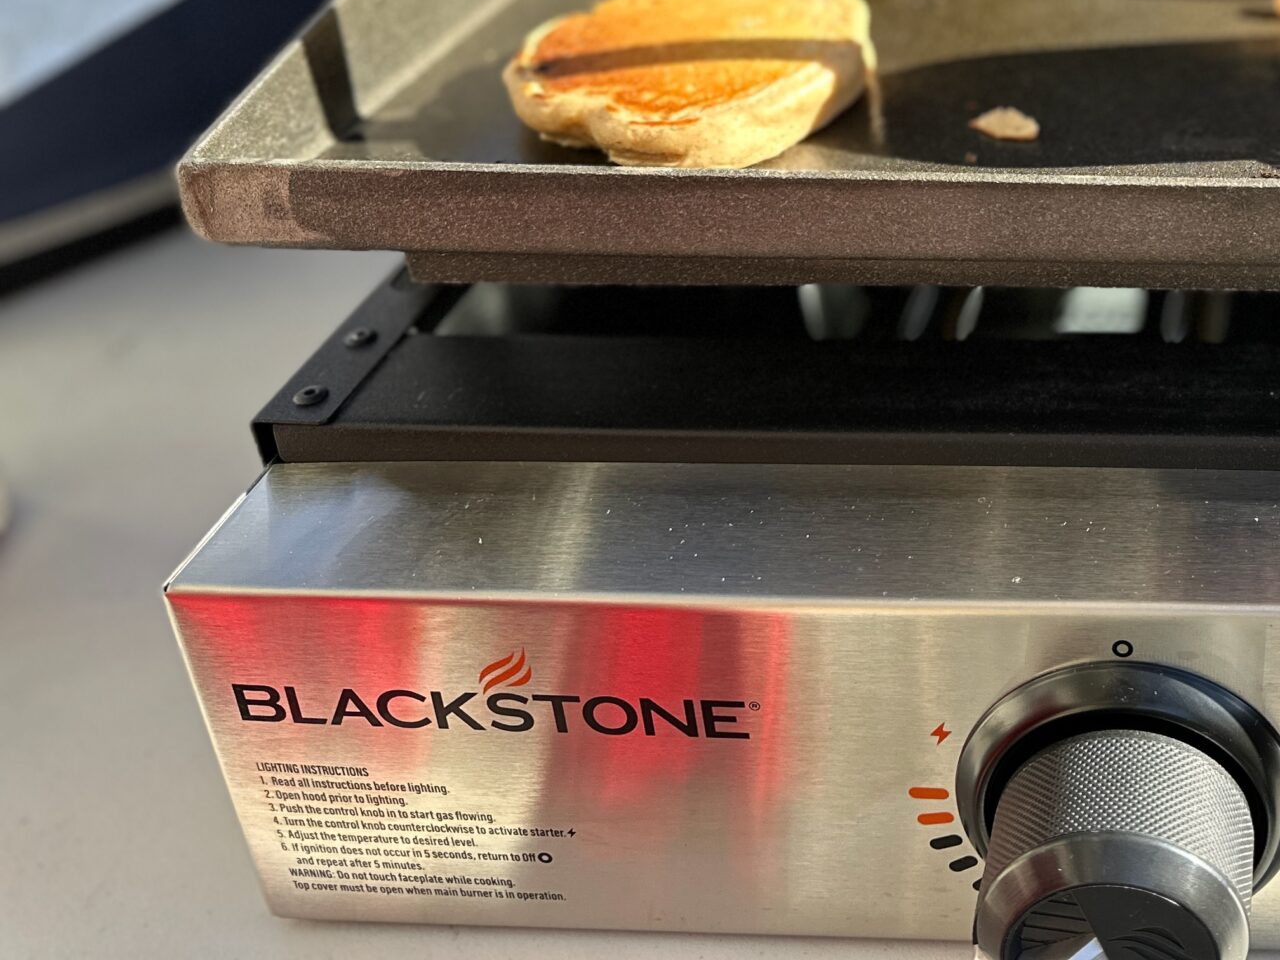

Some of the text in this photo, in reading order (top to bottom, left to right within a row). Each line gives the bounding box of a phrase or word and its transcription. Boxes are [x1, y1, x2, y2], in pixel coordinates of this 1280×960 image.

[256, 762, 370, 777] LIGHTING INSTRUCTIONS
[259, 776, 451, 796] 1. Read all instructions before lighting.
[264, 789, 409, 808] 2. Open hood prior to lighting.
[268, 803, 497, 824] 3. Push the control knob in to start gas flowing.
[273, 816, 567, 838] 4. Turn the control knob counterclockwise to activate starter.
[276, 829, 479, 847] 5. Adjust the temperature to desired level.
[280, 841, 536, 862] 6. If ignition does not occur in 5 seconds, return to Off
[297, 857, 425, 871] and repeat after 5 minutes.
[289, 868, 516, 889] WARNING: Do not touch faceplate while cooking.
[293, 880, 310, 891] Top
[312, 883, 338, 891] cover
[366, 884, 378, 893] be
[380, 887, 404, 895] open
[405, 886, 433, 895] when
[434, 888, 459, 896] main
[460, 888, 493, 898] burner
[495, 890, 504, 899] is
[506, 891, 515, 899] in
[517, 892, 567, 901] operation.
